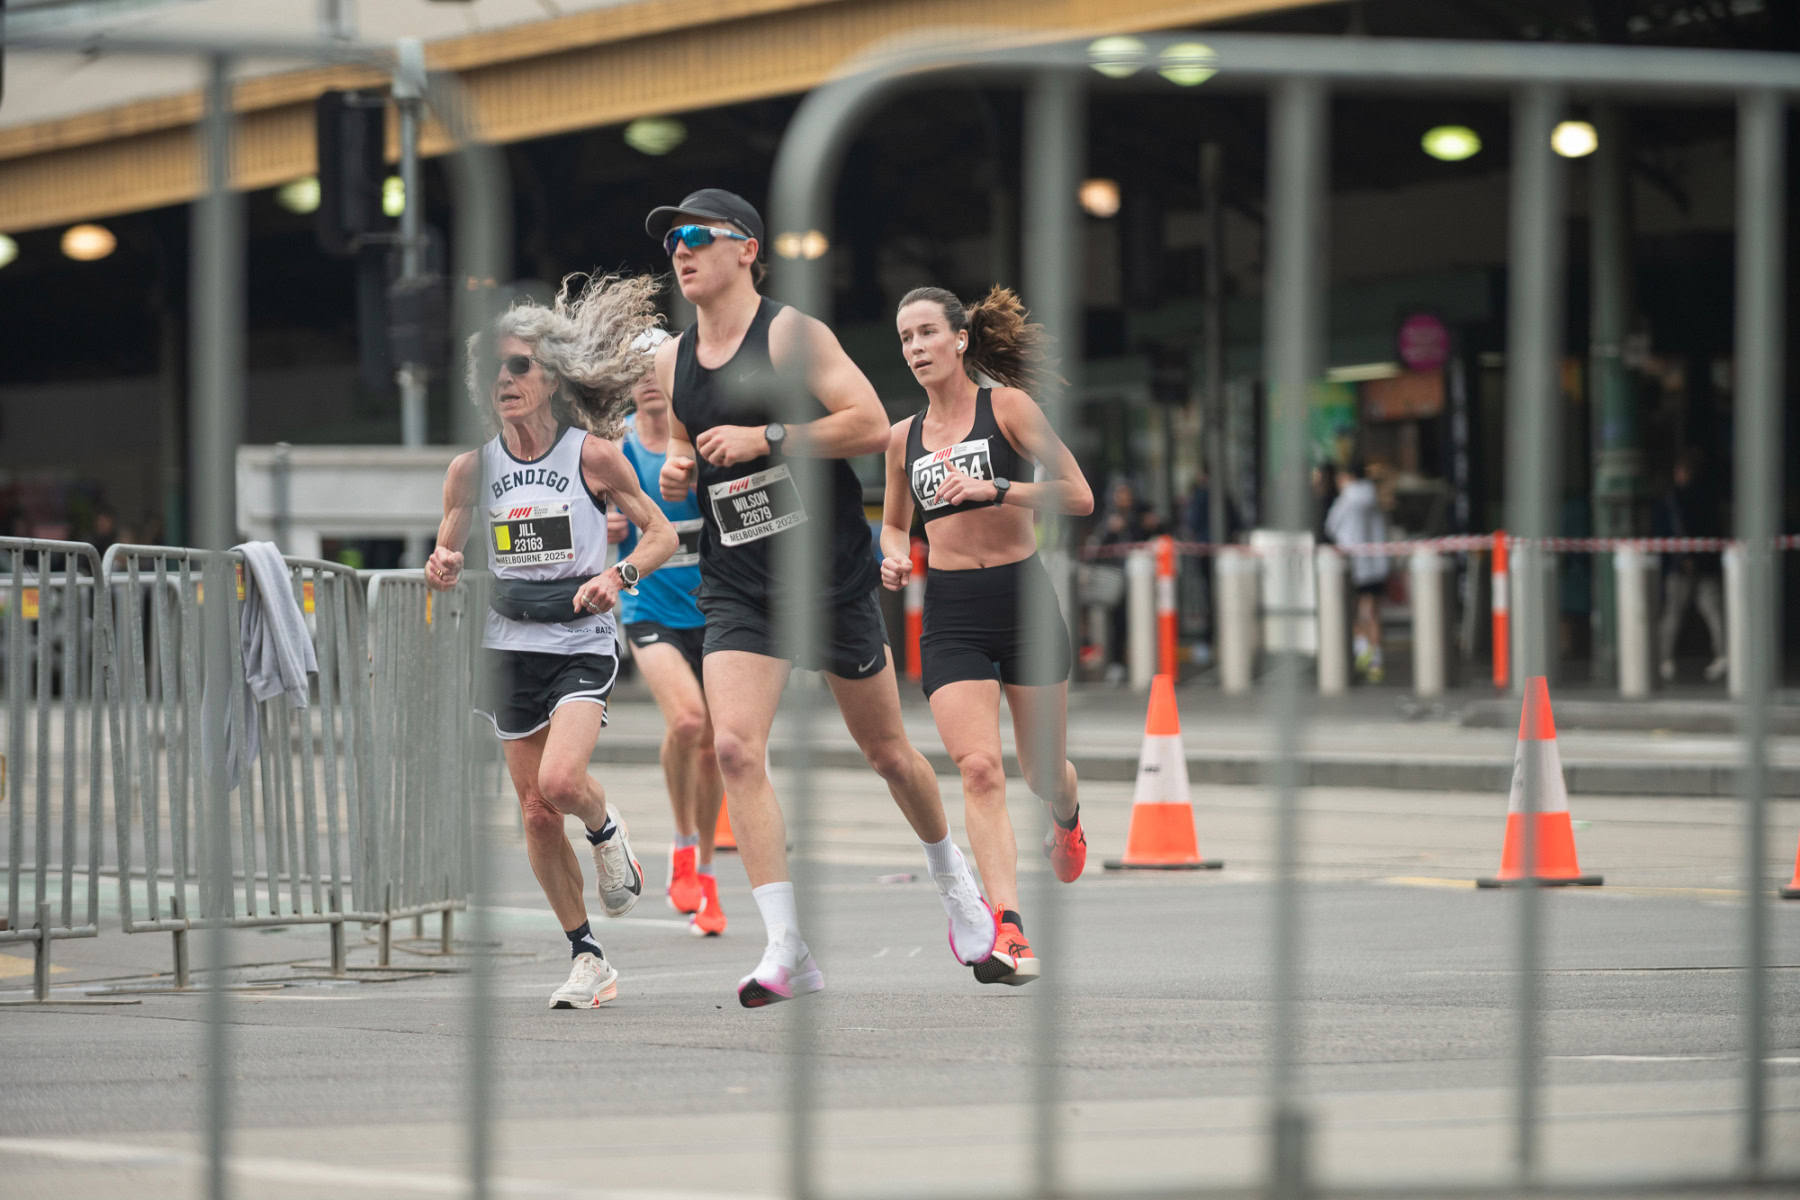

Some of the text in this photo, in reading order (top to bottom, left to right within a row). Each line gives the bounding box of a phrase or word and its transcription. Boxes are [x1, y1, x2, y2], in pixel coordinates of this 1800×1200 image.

[492, 468, 570, 499] BENDIGO
[920, 454, 985, 498] 2554
[732, 490, 770, 513] WILSON
[729, 513, 799, 542] MELBOURNE 2025
[741, 506, 773, 527] 22679
[518, 522, 537, 538] JILL
[514, 537, 544, 552] 23163
[544, 551, 566, 561] 2025
